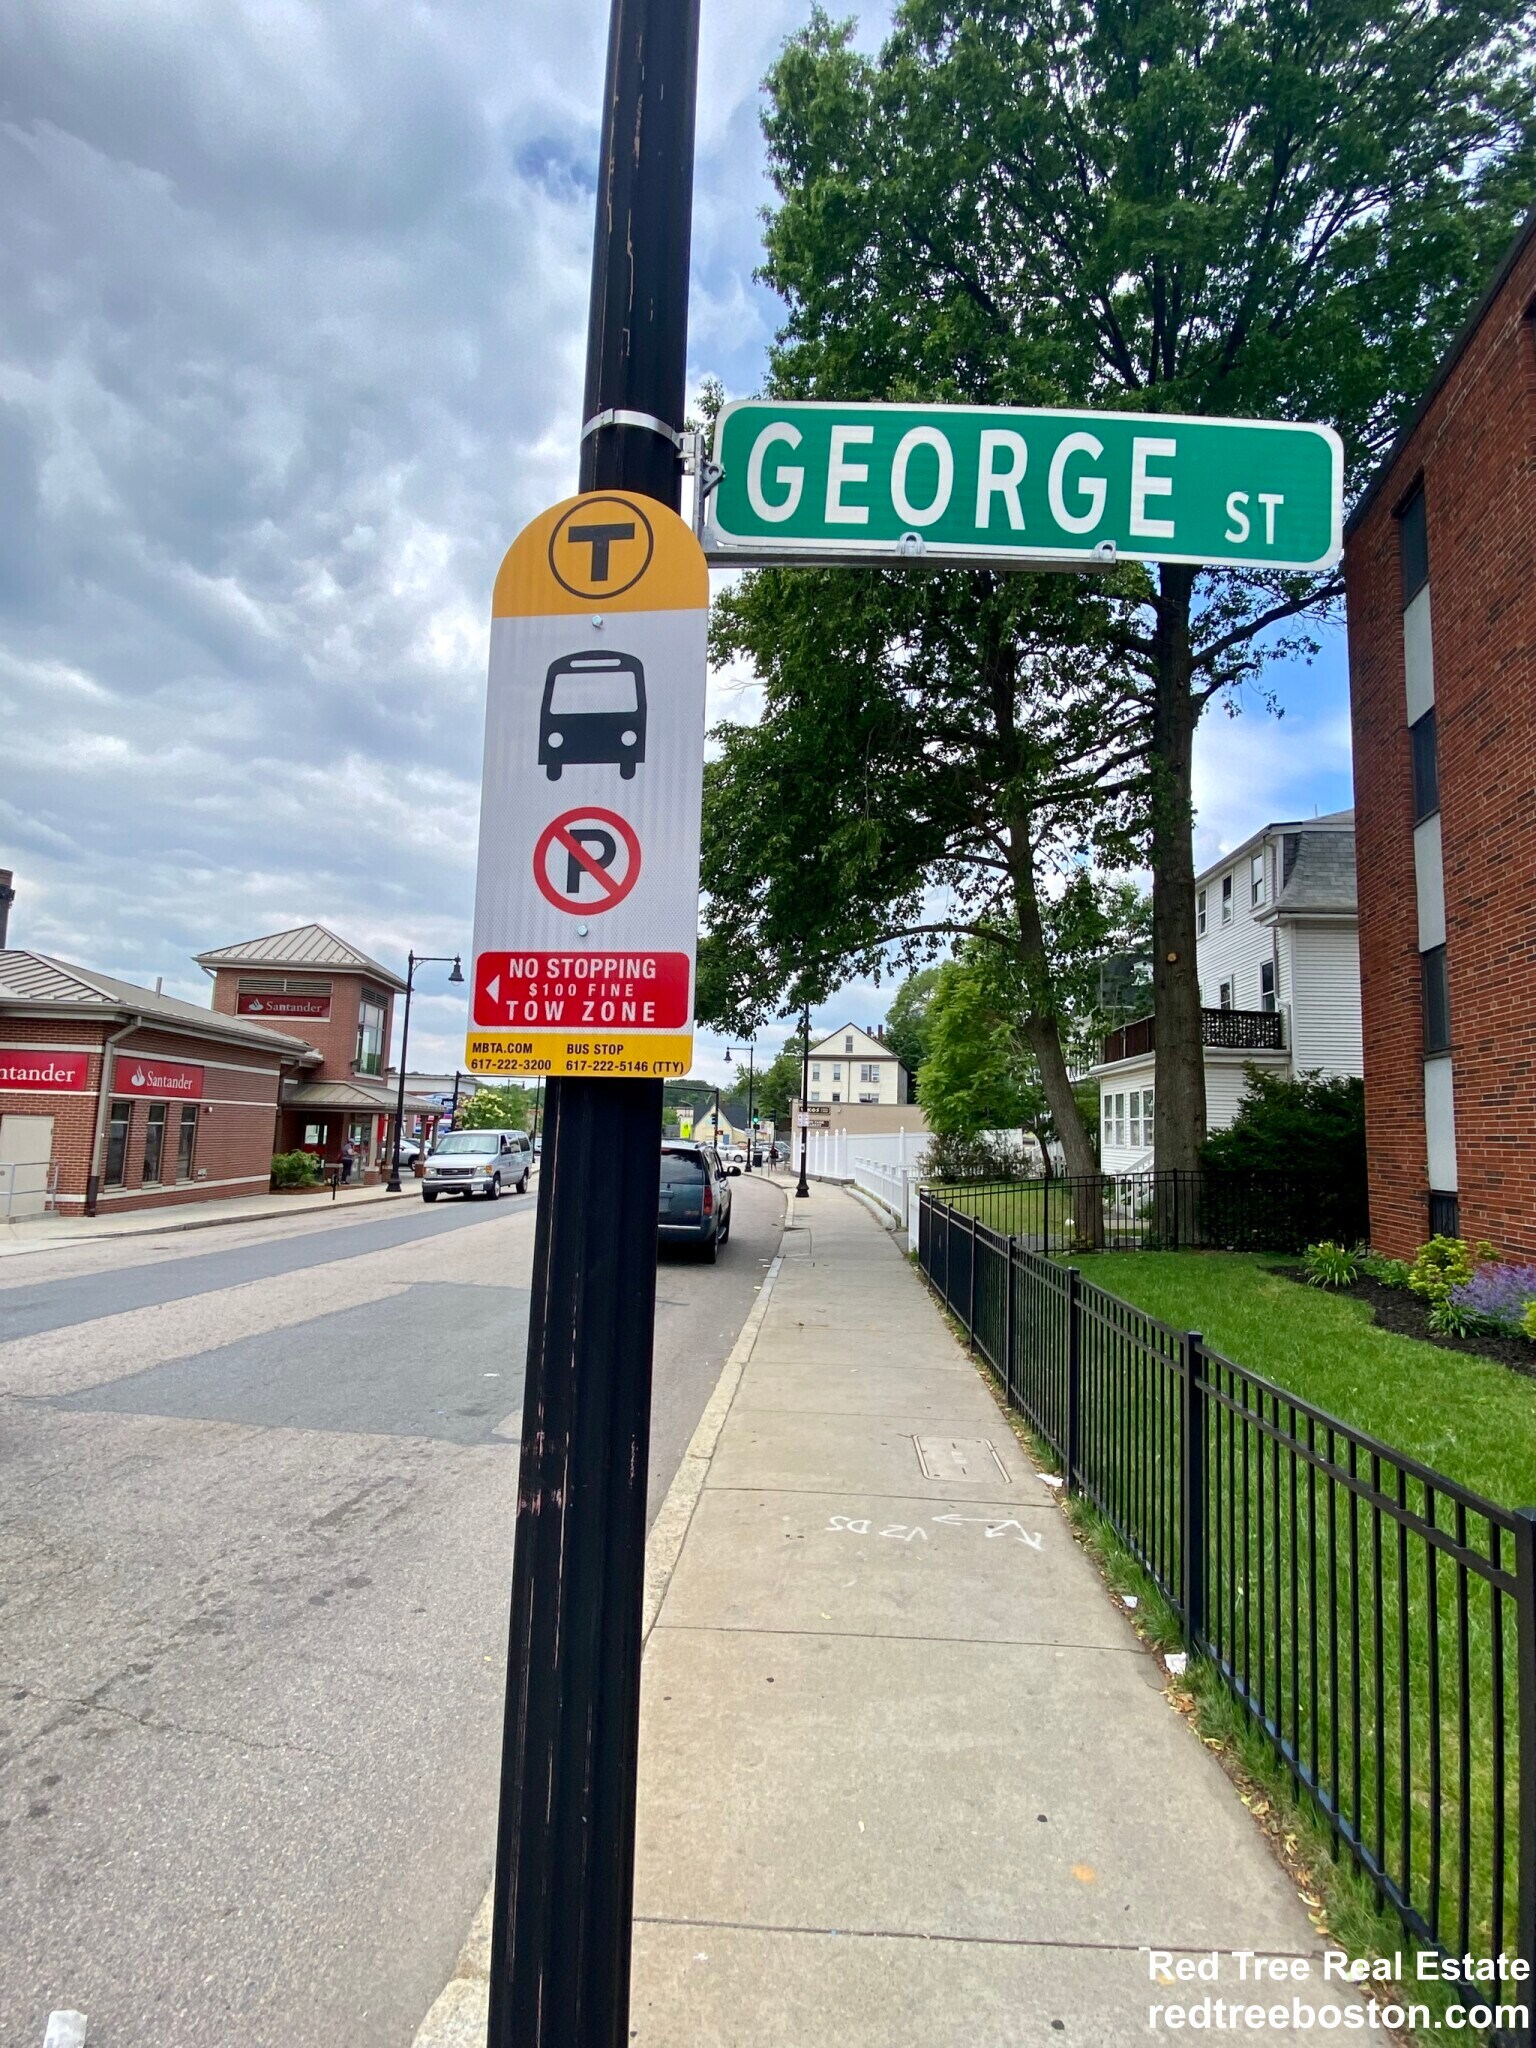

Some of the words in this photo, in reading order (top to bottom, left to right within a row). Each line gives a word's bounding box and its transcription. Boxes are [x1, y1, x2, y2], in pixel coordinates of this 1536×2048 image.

[746, 421, 1177, 538] GEORGE
[1224, 490, 1284, 544] ST
[568, 523, 635, 582] T
[509, 958, 538, 978] NO
[546, 958, 656, 979] STOPPING
[529, 983, 577, 997] $100
[588, 983, 634, 997] FINE
[266, 1001, 322, 1013] Santander
[506, 1000, 564, 1021] TOW
[581, 1001, 656, 1022] ZONE
[472, 1042, 533, 1054] MBTA.COM
[566, 1043, 590, 1055] BUS
[594, 1044, 624, 1055] STOP
[471, 1058, 551, 1071] 617-222-3200
[566, 1060, 648, 1072] 617-222-5146
[652, 1061, 684, 1074] (TTY)
[146, 1070, 193, 1090] Santander
